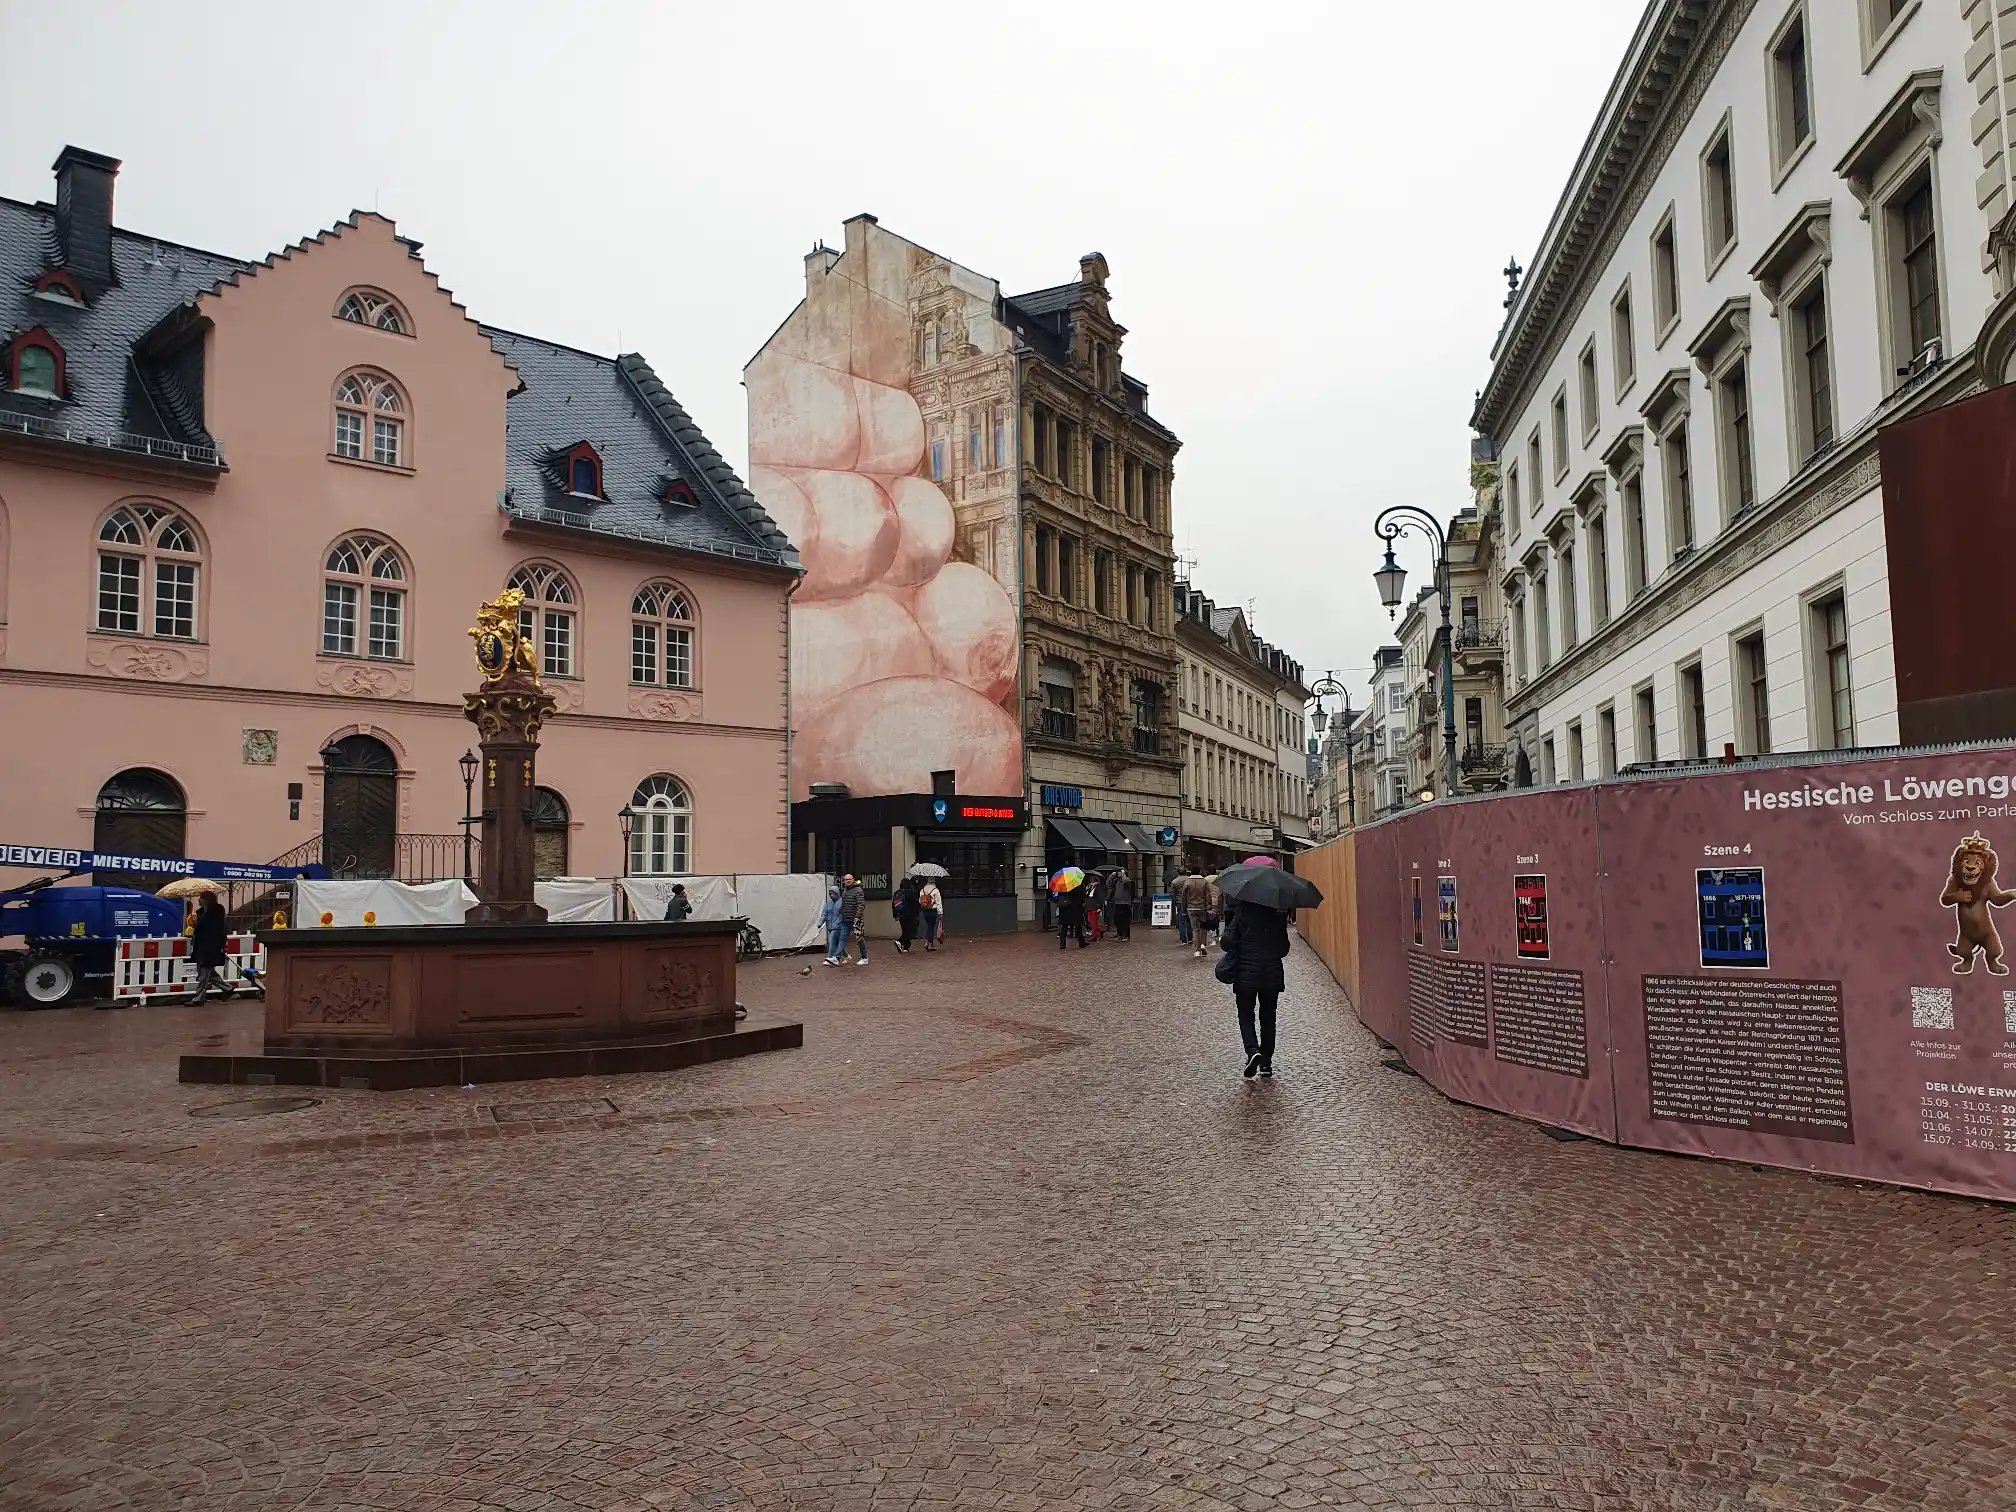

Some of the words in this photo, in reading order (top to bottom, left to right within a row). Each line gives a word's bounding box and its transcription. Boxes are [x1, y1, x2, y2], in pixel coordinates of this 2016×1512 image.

[1045, 786, 1082, 808] BREWDOG
[1744, 782, 1874, 810] Hessische
[1884, 775, 2016, 802] Löweng
[1844, 812, 1874, 825] Vom
[1880, 809, 1934, 824] Schloss
[1938, 808, 1970, 820] zum
[1976, 803, 2016, 818] Parla
[1704, 845, 1740, 856] Szene
[1743, 843, 1752, 854] 4
[1516, 854, 1534, 864] Szene
[1534, 854, 1538, 863] 3
[862, 874, 887, 889] WINGS
[1738, 990, 1775, 998] Österreichs
[1927, 1041, 1946, 1049] Infos
[1916, 1050, 1956, 1060] Projektion
[1718, 1067, 1741, 1075] Schloss
[1816, 1087, 1844, 1096] Pendant
[1926, 1082, 1948, 1092] DER
[1952, 1083, 1985, 1096] LÖWE
[1988, 1087, 2016, 1098] ERW
[1921, 1097, 1952, 1108] 15.09.
[1814, 1107, 1846, 1117] erscheint
[1922, 1109, 1952, 1120] 01.04.
[1922, 1121, 1953, 1132] 01.06.
[1924, 1134, 1954, 1145] 15.07.
